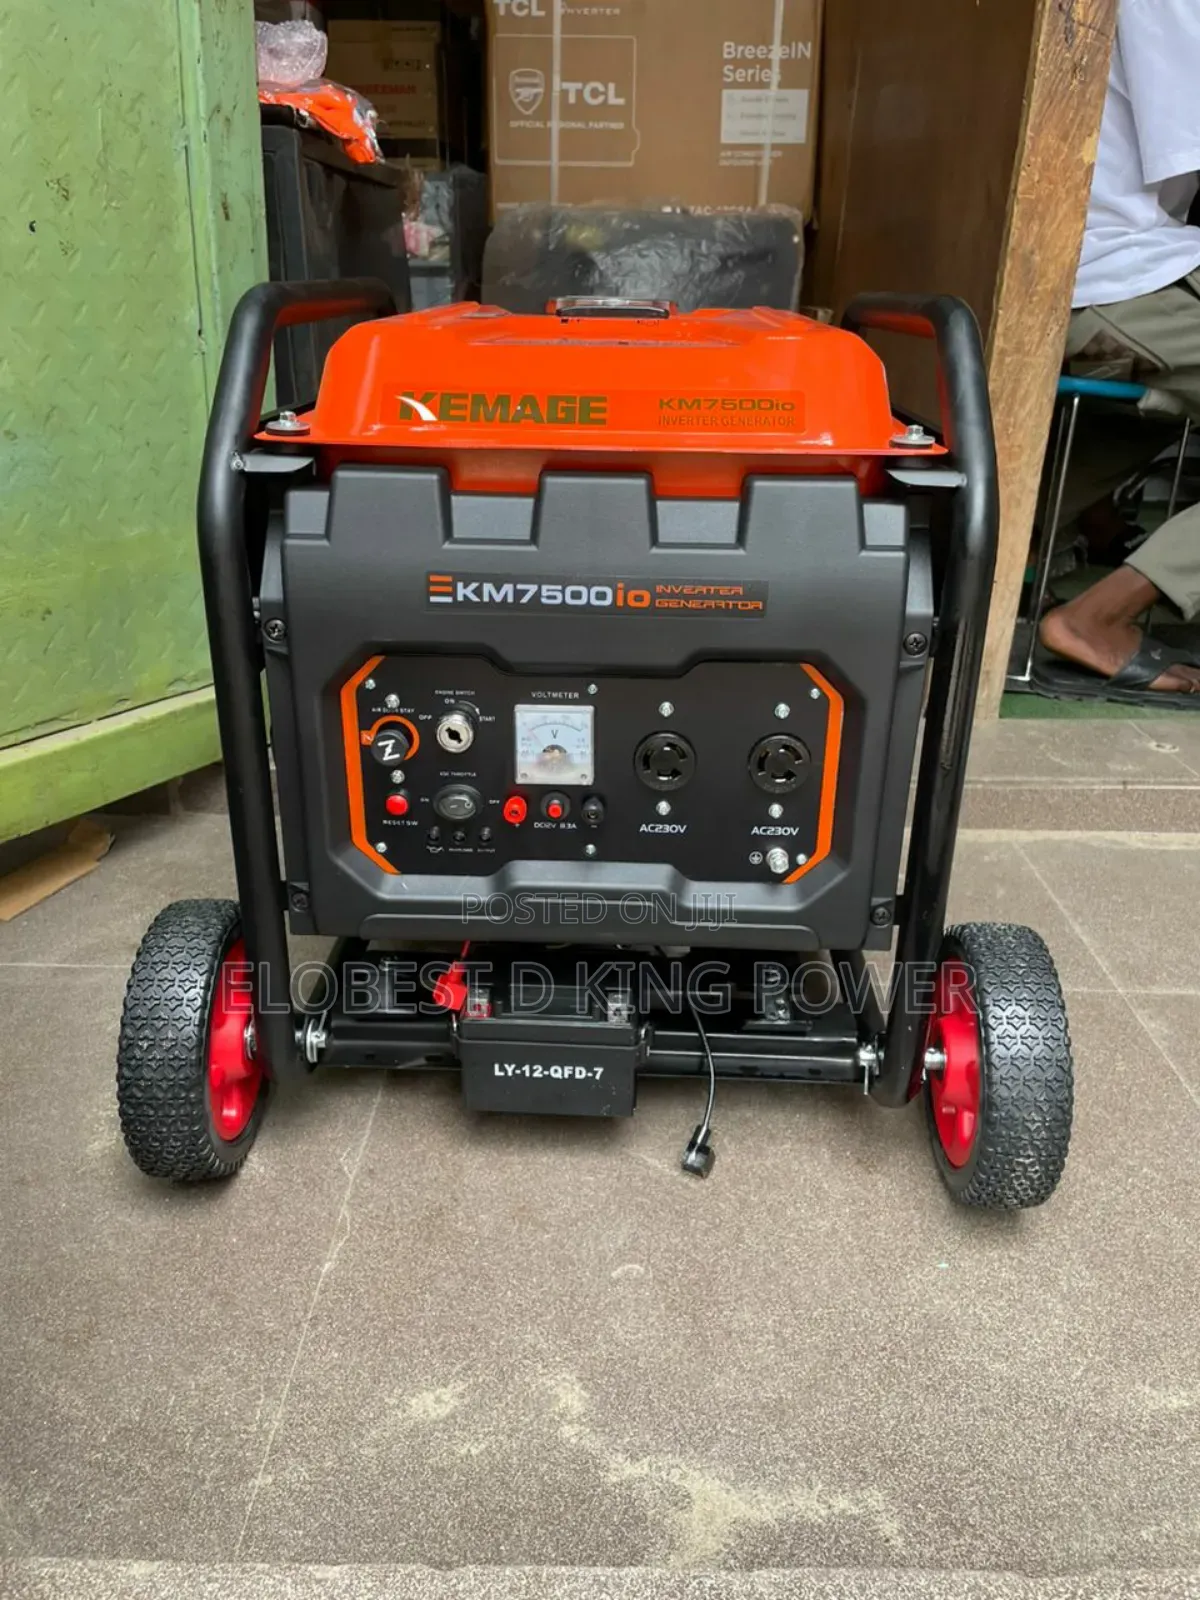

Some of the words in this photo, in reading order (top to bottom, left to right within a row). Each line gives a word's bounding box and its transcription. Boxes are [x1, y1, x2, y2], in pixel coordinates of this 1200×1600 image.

[493, 0, 546, 17] TCL
[561, 81, 626, 105] TCL
[396, 390, 607, 425] KEMAGE
[658, 398, 796, 412] KM7500io
[658, 415, 718, 427] INVERTER
[721, 415, 796, 427] GENERATOR
[456, 581, 651, 608] KM7500io
[655, 584, 743, 596] INVERTER
[655, 598, 763, 610] GENERATOR
[531, 691, 580, 699] VOLTMETER
[551, 729, 559, 739] V
[639, 823, 687, 834] AC230V
[750, 826, 799, 836] AC230V
[494, 1063, 604, 1080] LY-12-QFD-7
